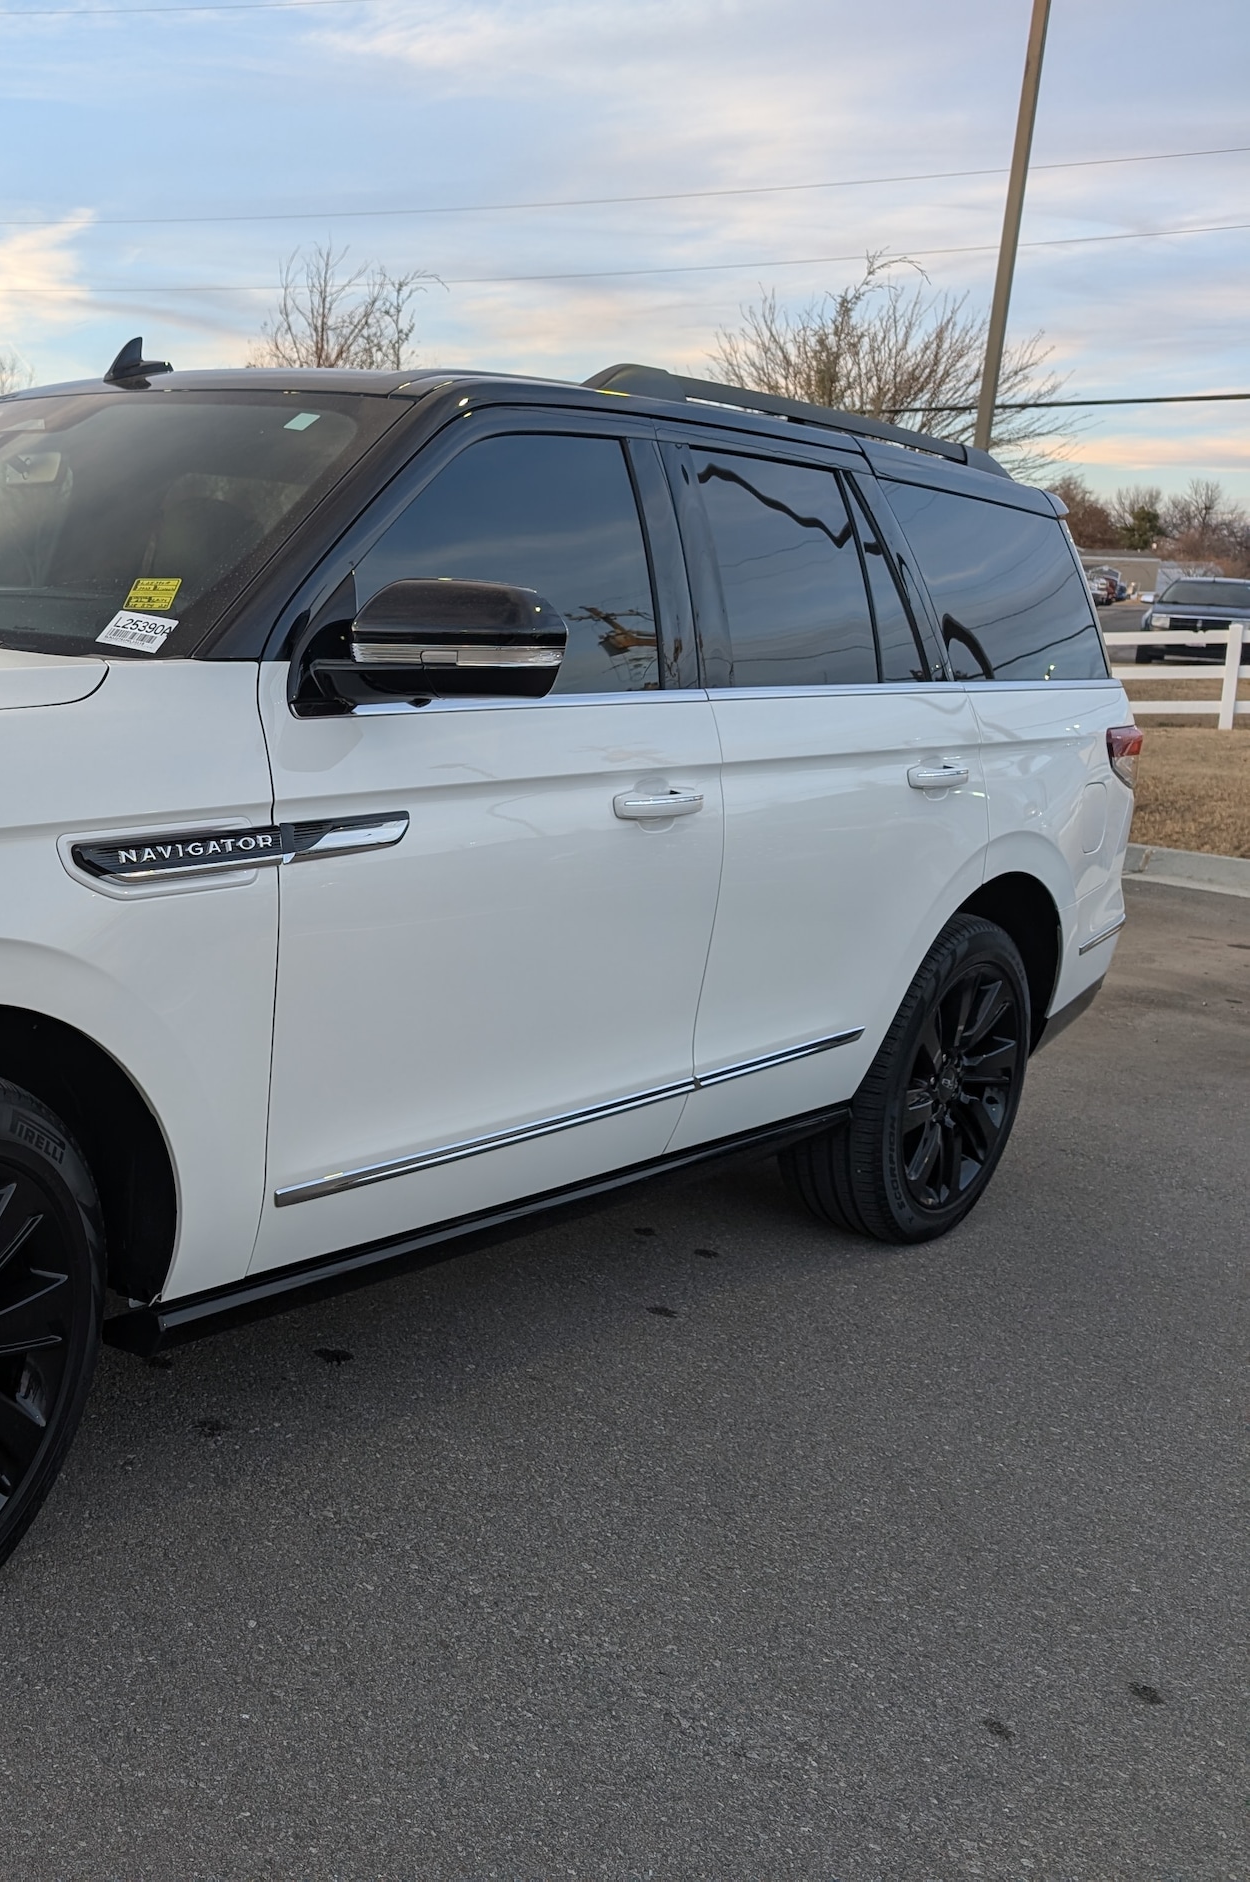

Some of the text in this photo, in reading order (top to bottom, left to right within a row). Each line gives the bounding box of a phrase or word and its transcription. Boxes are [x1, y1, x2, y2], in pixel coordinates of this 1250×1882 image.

[114, 617, 172, 636] L25390A
[117, 834, 273, 864] NAVIGATOR
[9, 1109, 65, 1164] PIRELLI
[888, 1115, 906, 1210] SCORPION
